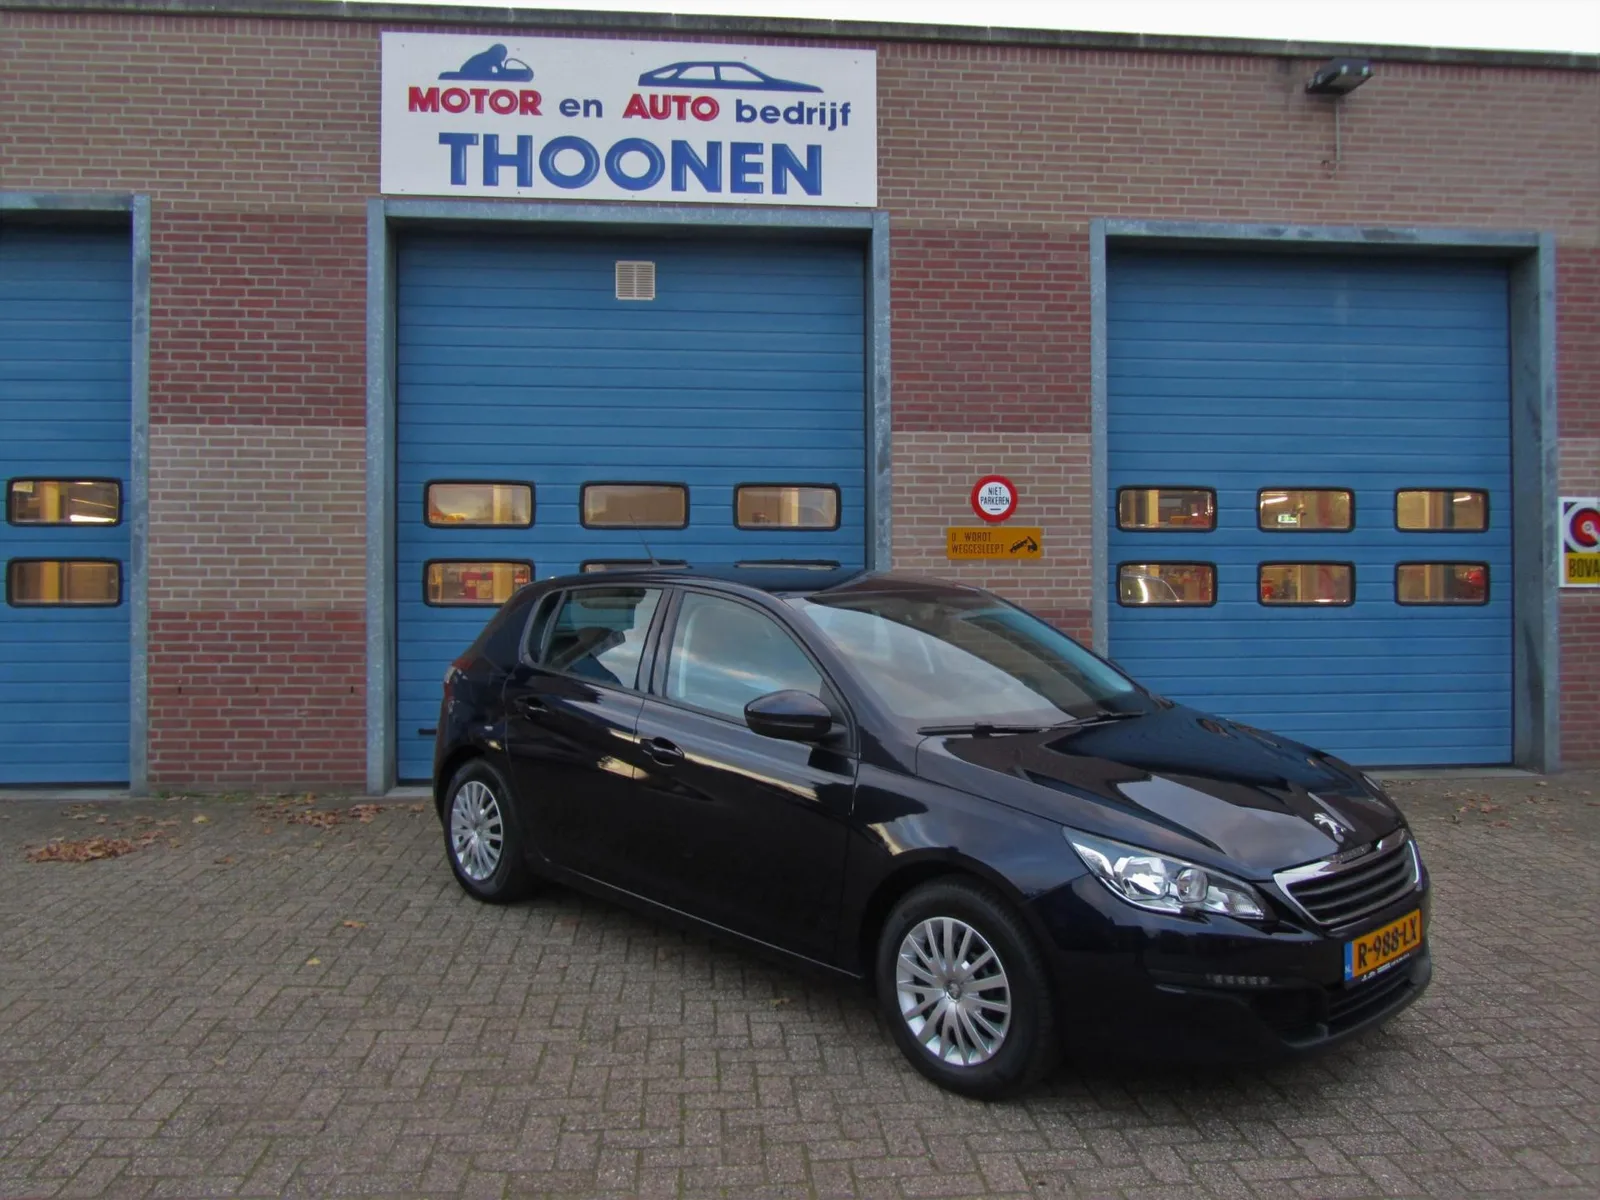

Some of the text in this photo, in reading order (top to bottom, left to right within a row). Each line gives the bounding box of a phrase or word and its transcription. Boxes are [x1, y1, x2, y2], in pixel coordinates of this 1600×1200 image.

[408, 86, 851, 131] MOTOR en AUTO bedrijf
[438, 132, 822, 196] THOONEN
[980, 496, 1010, 506] PARKEREN
[987, 486, 1002, 496] NIET
[951, 543, 1004, 554] WEGGESLEEPT
[1357, 915, 1417, 970] R-988-LX
